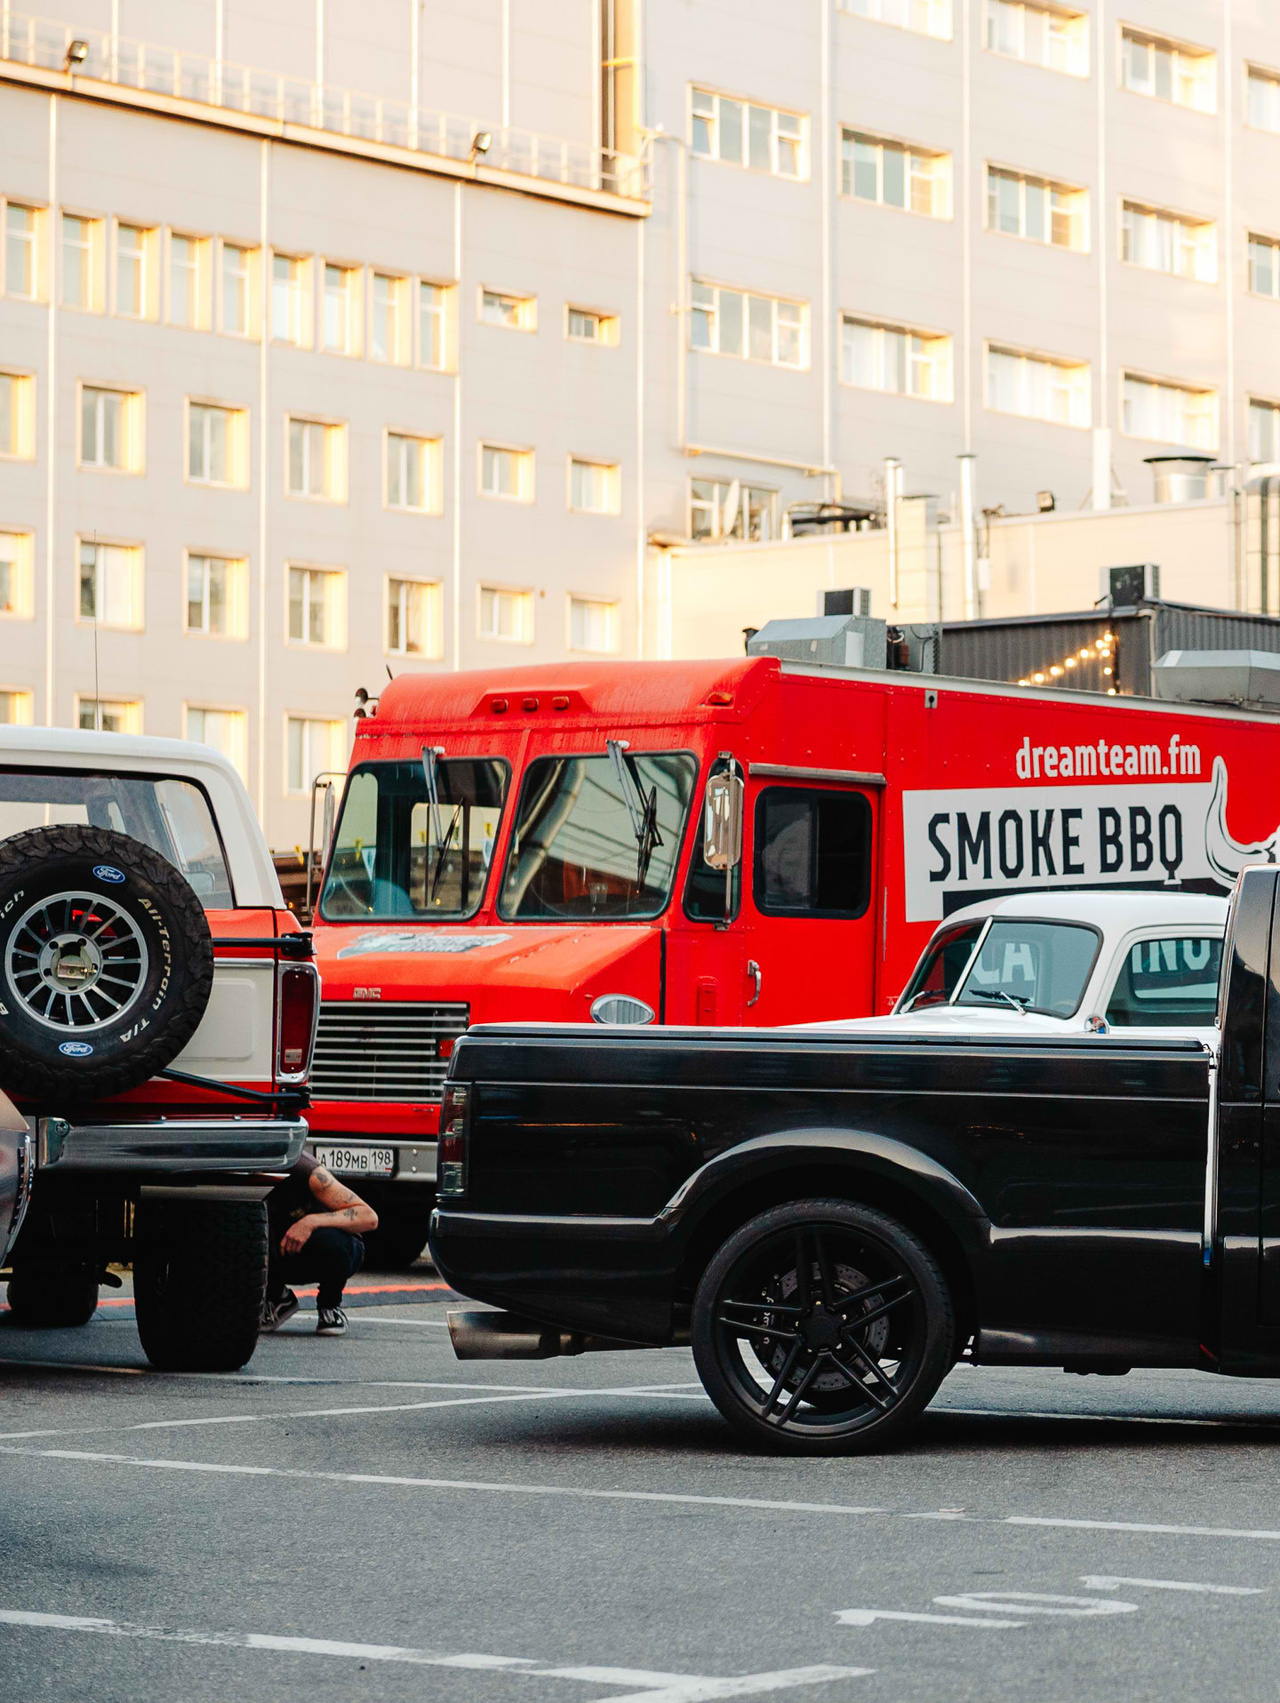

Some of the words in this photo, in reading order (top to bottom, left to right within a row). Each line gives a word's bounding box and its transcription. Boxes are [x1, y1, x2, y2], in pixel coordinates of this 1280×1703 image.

[1016, 734, 1201, 780] dreamteam.fm
[928, 808, 1085, 883] SMOKE
[1098, 804, 1183, 881] BBQ
[95, 866, 123, 882] Ford
[138, 898, 172, 1011] All-Terrain
[120, 1017, 150, 1043] T/A
[61, 1043, 91, 1055] Ford
[371, 1151, 392, 1165] 198
